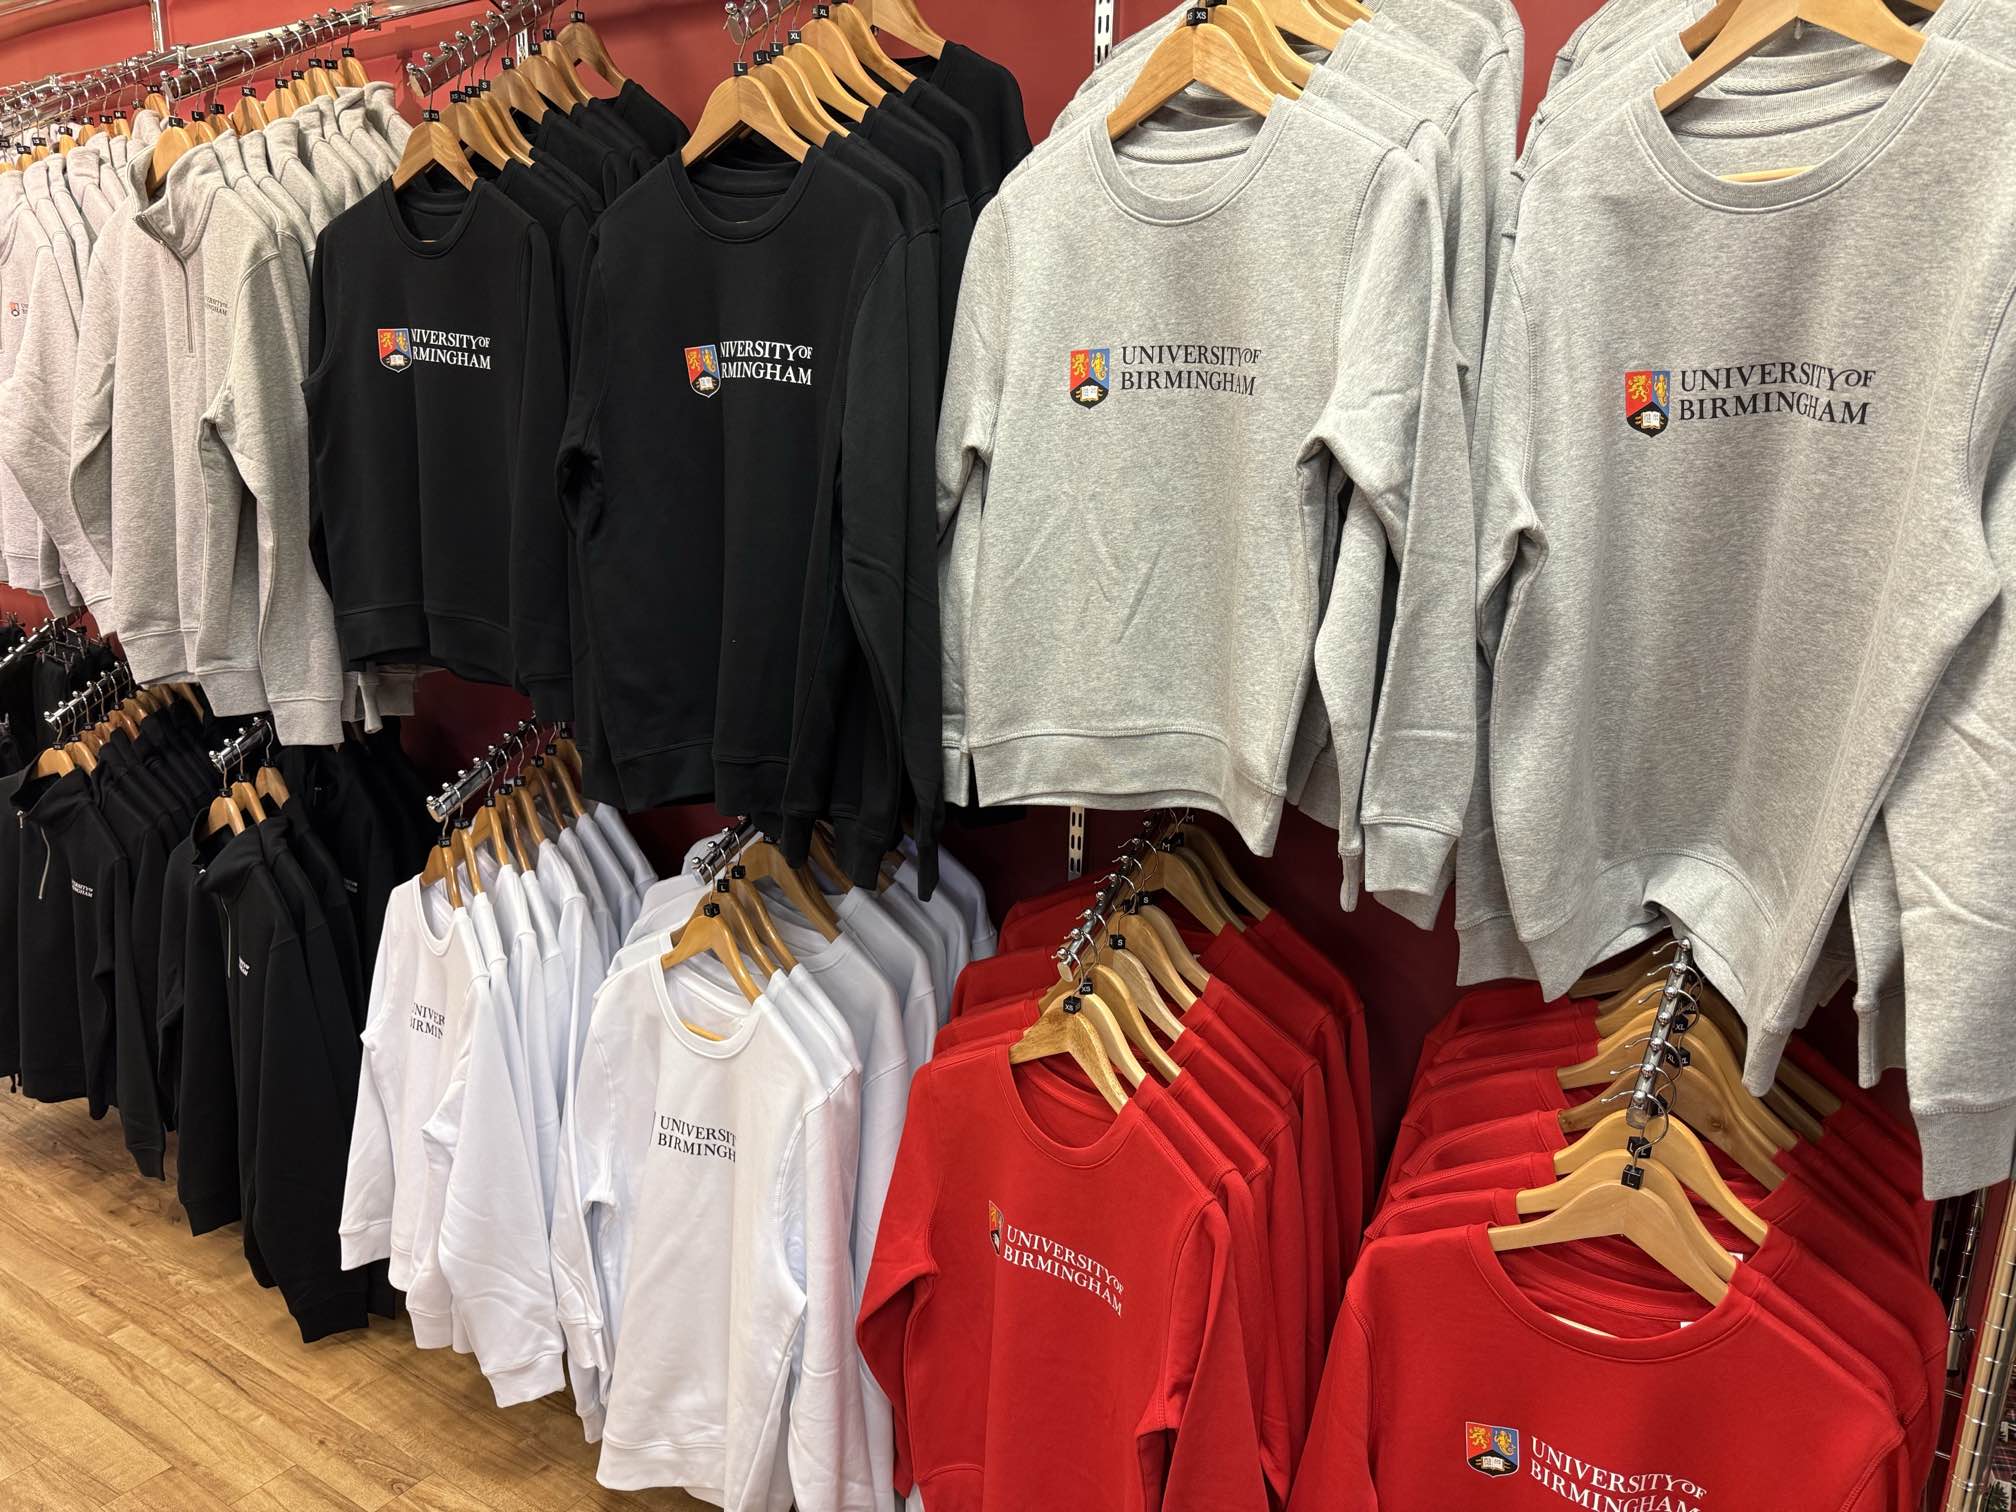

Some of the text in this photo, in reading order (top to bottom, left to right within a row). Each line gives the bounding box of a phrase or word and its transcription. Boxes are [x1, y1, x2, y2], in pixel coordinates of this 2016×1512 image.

[1196, 11, 1207, 20] XS
[545, 30, 552, 38] M
[411, 328, 491, 349] NIVERSITY OF
[412, 346, 492, 370] RMINGHAM
[720, 340, 813, 361] NIVERSITY OF
[1121, 345, 1261, 367] UNIVERSITY OF
[721, 361, 812, 386] RMINGHAM
[1121, 370, 1256, 396] BIRMINGHAM
[1681, 361, 1876, 392] UNIVERSITY OF
[1679, 391, 1872, 425] BIRMINGHAM
[1162, 842, 1170, 852] M
[411, 1002, 446, 1026] NIVER
[1065, 1003, 1074, 1011] XS
[410, 1016, 443, 1039] IRMIN
[1675, 1023, 1686, 1031] XL
[1668, 1053, 1676, 1063] XL
[660, 1115, 736, 1147] UNIVERSIT
[658, 1132, 736, 1163] BIRMINGH
[1627, 1174, 1635, 1186] L
[1006, 1224, 1124, 1295] UNIVERSITY OF
[1003, 1243, 1122, 1318] BIRMINGHAM
[1531, 1435, 1707, 1500] UNIVERSITY OF
